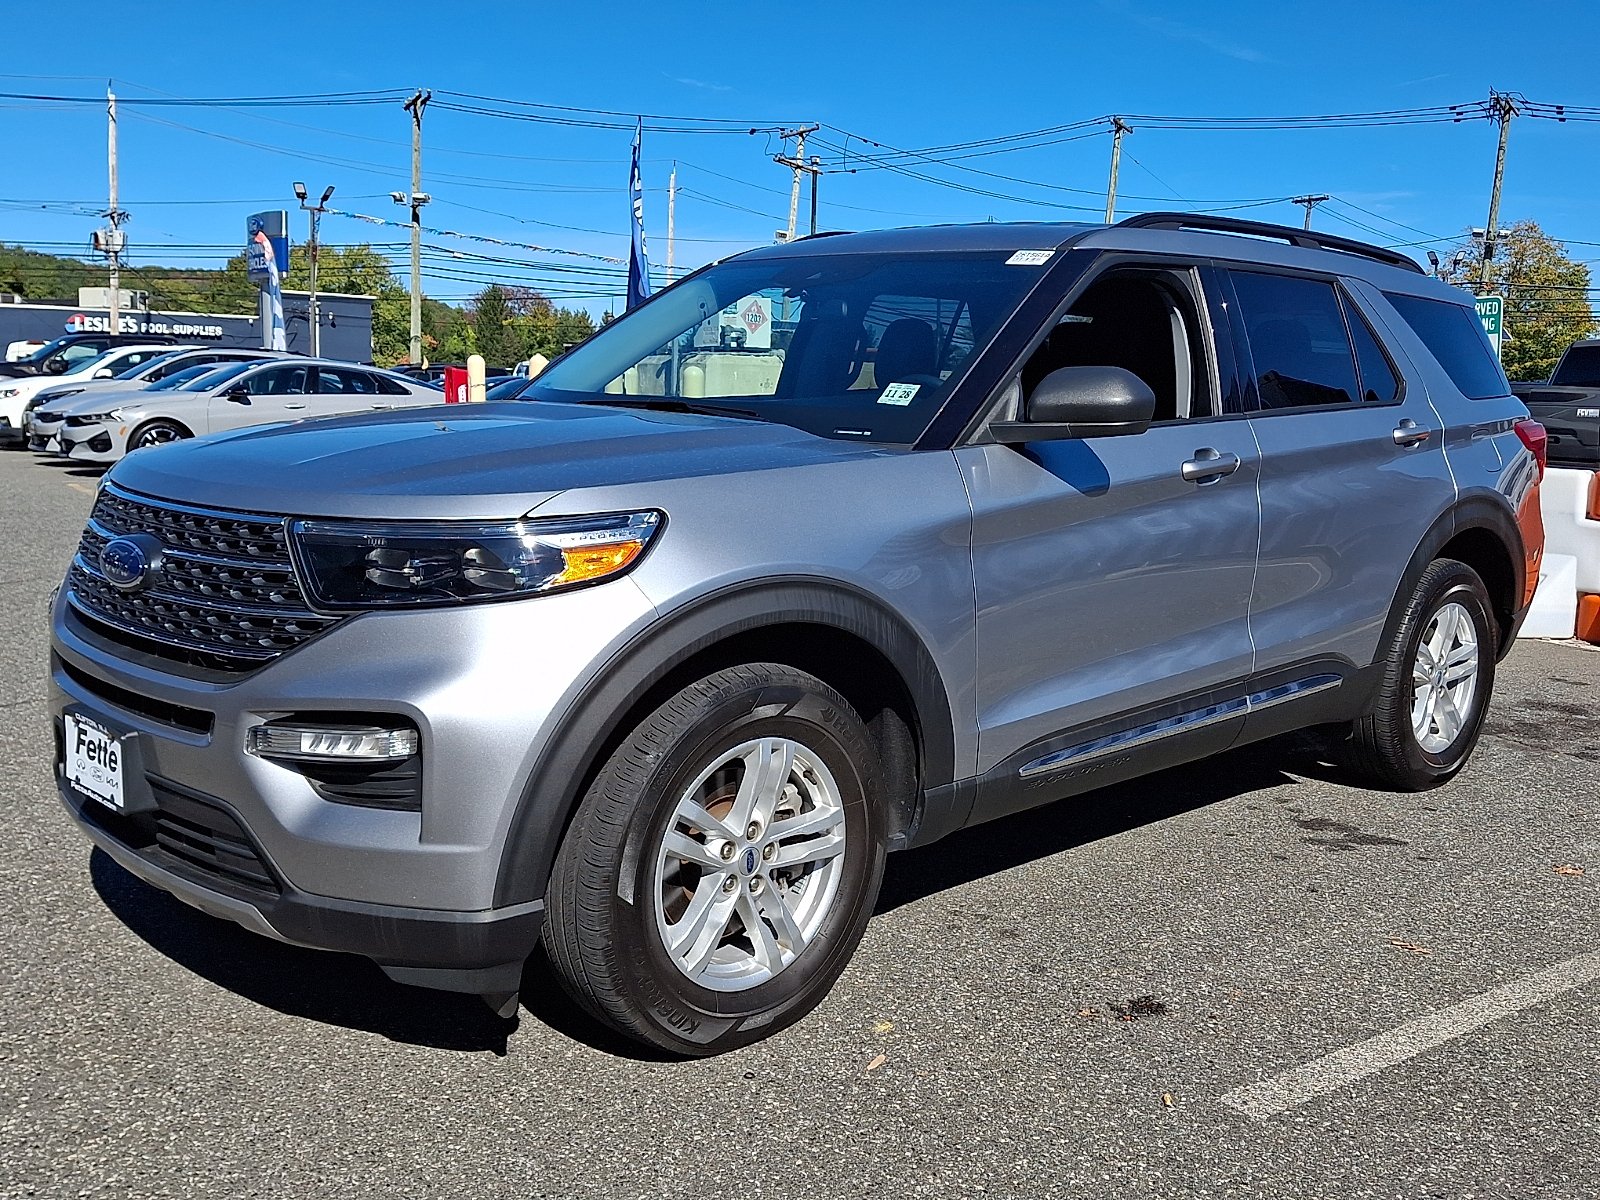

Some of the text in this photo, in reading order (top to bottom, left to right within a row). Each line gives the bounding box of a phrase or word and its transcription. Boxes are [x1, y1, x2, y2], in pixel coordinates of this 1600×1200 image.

[746, 313, 762, 323] 1203
[1481, 318, 1495, 331] NG
[74, 315, 223, 337] LESLE'S POOL SUPPLIES
[884, 389, 912, 399] 11 28
[75, 727, 118, 773] Fette
